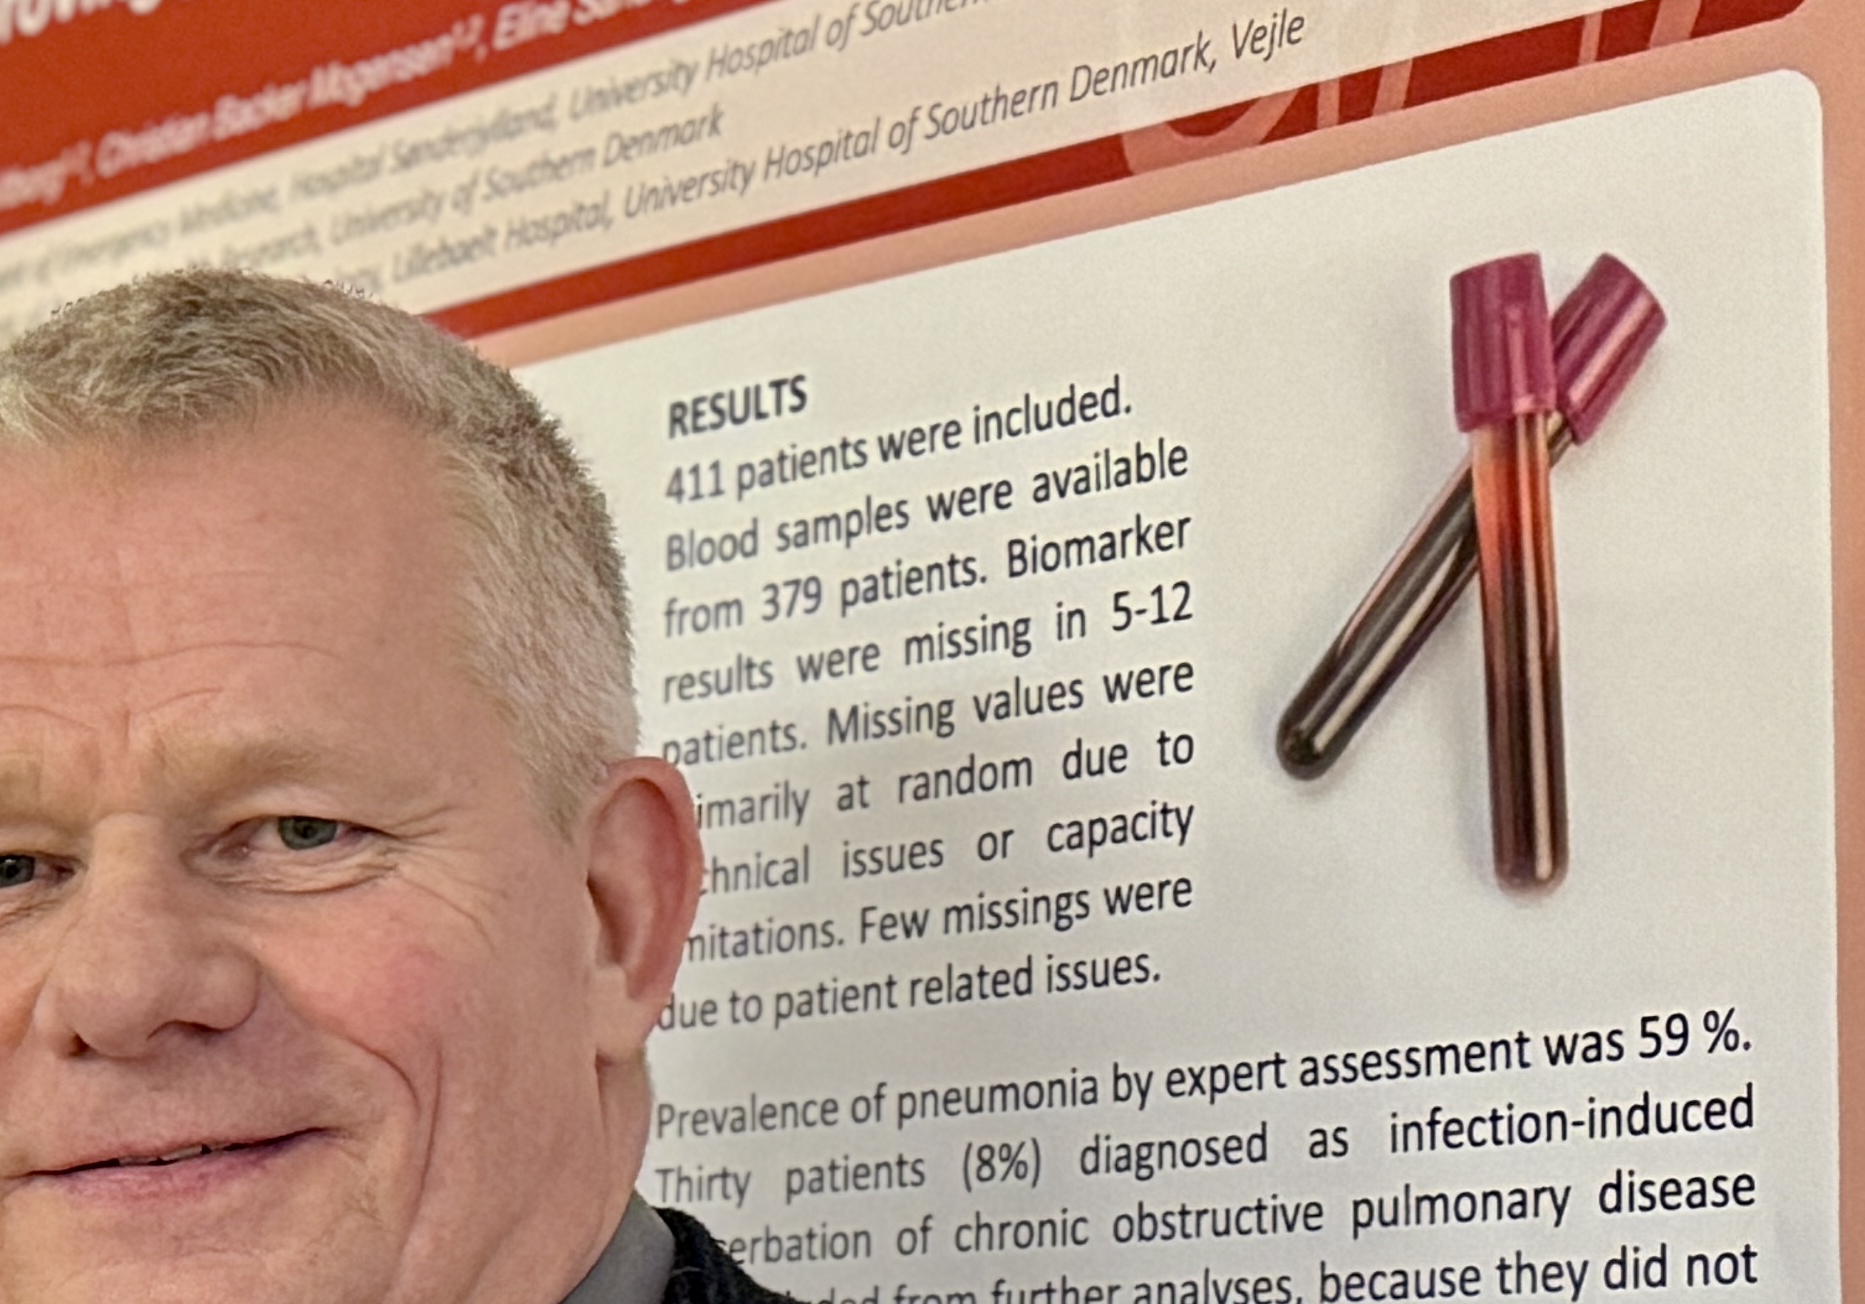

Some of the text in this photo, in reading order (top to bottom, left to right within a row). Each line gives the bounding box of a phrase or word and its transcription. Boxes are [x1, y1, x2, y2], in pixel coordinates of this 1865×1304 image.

[569, 57, 700, 122] University
[706, 16, 818, 82] Hospital
[824, 3, 861, 52] of
[480, 141, 596, 203] Southern
[602, 103, 726, 168] Denmark
[504, 190, 614, 252] Hospital,
[624, 152, 756, 219] University
[765, 118, 881, 182] Hospital
[887, 107, 921, 157] of
[924, 77, 1060, 142] Southern
[1068, 29, 1220, 102] Denmark,
[1231, 8, 1307, 63] Vejle
[665, 373, 1132, 504] 411 patients were included.
[668, 373, 808, 439] RESULTS
[666, 436, 1188, 572] Blood samples were available
[663, 513, 1192, 638] from 379 patients. Biomarker
[664, 580, 1193, 704] results were missing in 5-12
[663, 661, 1194, 767] patients. Missing values were
[696, 730, 1194, 830] imarily at random due to
[700, 799, 1195, 897] hnical issues or capacity
[860, 905, 930, 945] Few
[943, 886, 1090, 935] missings
[1103, 877, 1193, 916] were
[658, 953, 1161, 1031] due to patient related issues.
[657, 1007, 1752, 1139] Prevalence of pneumonia by expert assessment was 59 %.
[655, 1081, 1754, 1209] Thirty patients (8%) diagnosed as infection-induced
[718, 1168, 1756, 1266] erbation of chronic obstructive pulmonary disease
[1319, 1260, 1482, 1304] because
[1495, 1249, 1590, 1303] they
[1603, 1242, 1667, 1291] did
[1686, 1243, 1758, 1287] not
